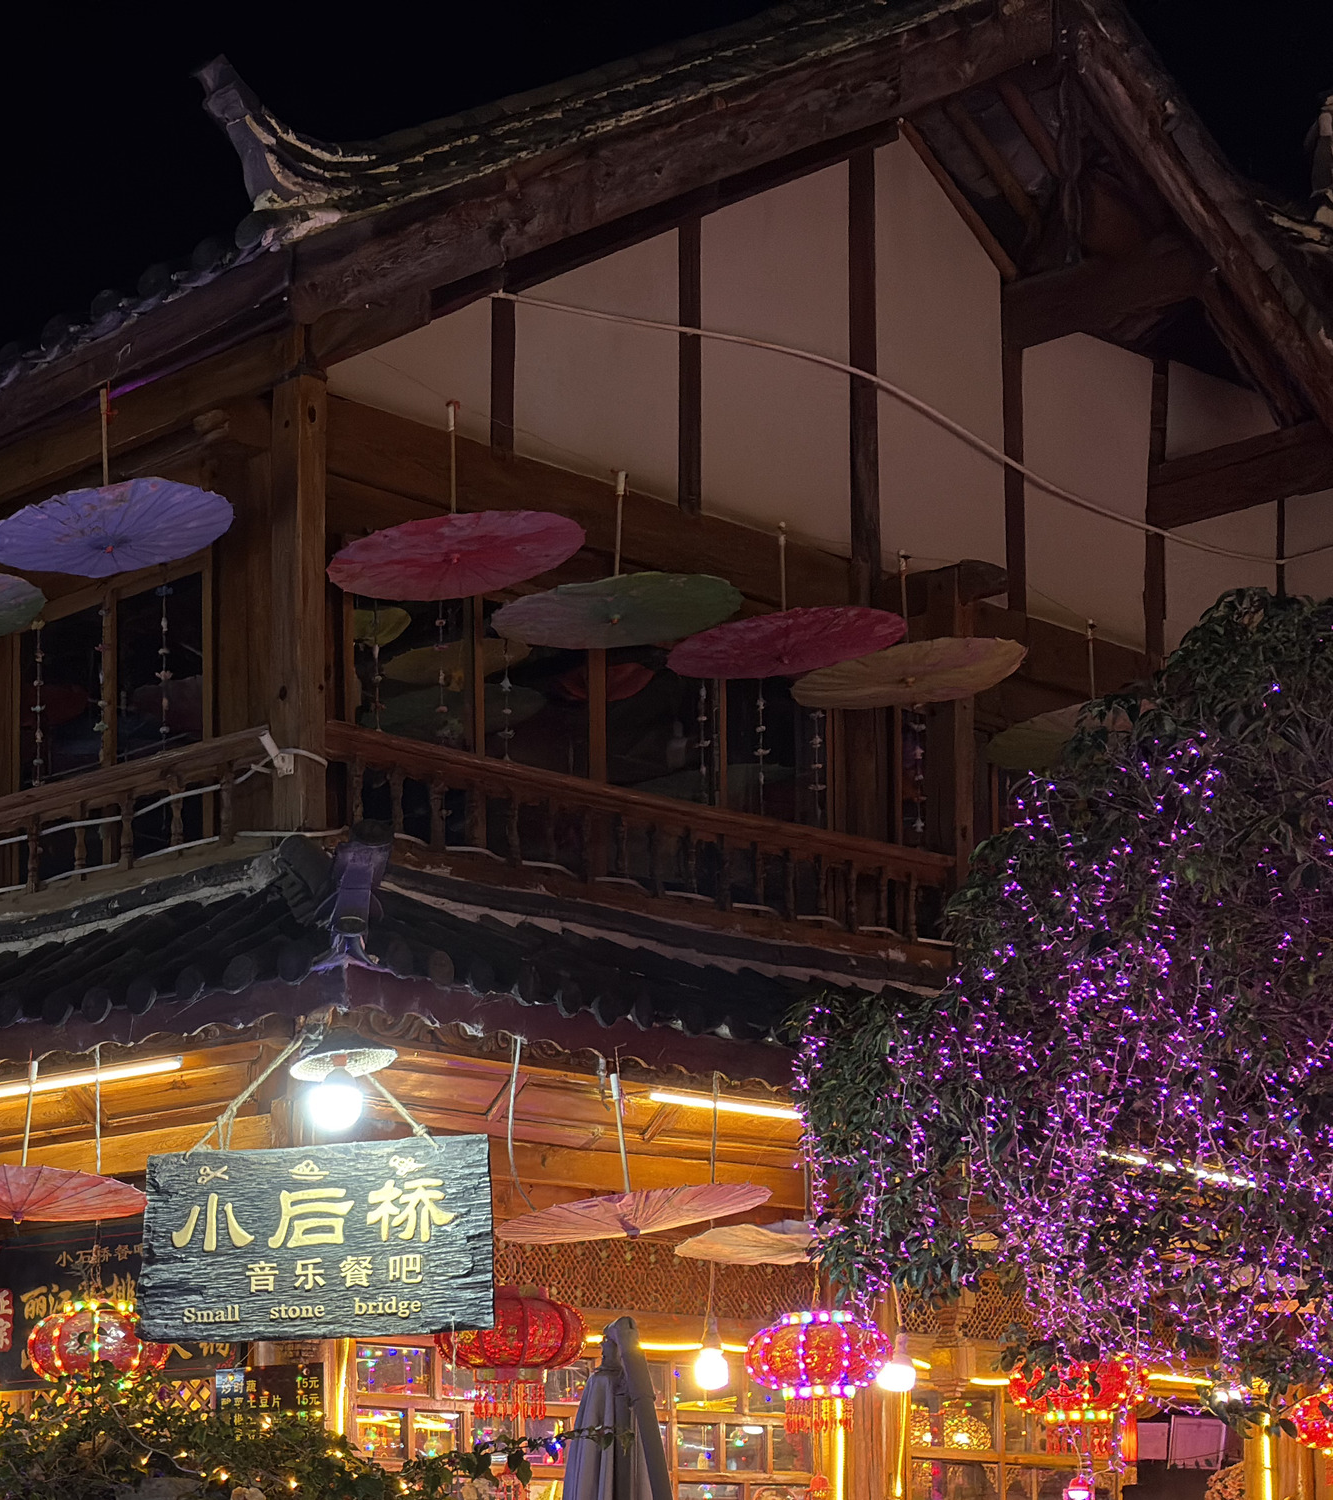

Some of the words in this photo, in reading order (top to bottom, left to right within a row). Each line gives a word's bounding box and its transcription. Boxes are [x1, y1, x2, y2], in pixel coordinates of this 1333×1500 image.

[246, 1254, 424, 1293] 音乐餐吧
[183, 1305, 241, 1324] Small
[269, 1302, 326, 1321] stone
[353, 1297, 422, 1320] bridge
[296, 1376, 320, 1389] 15元
